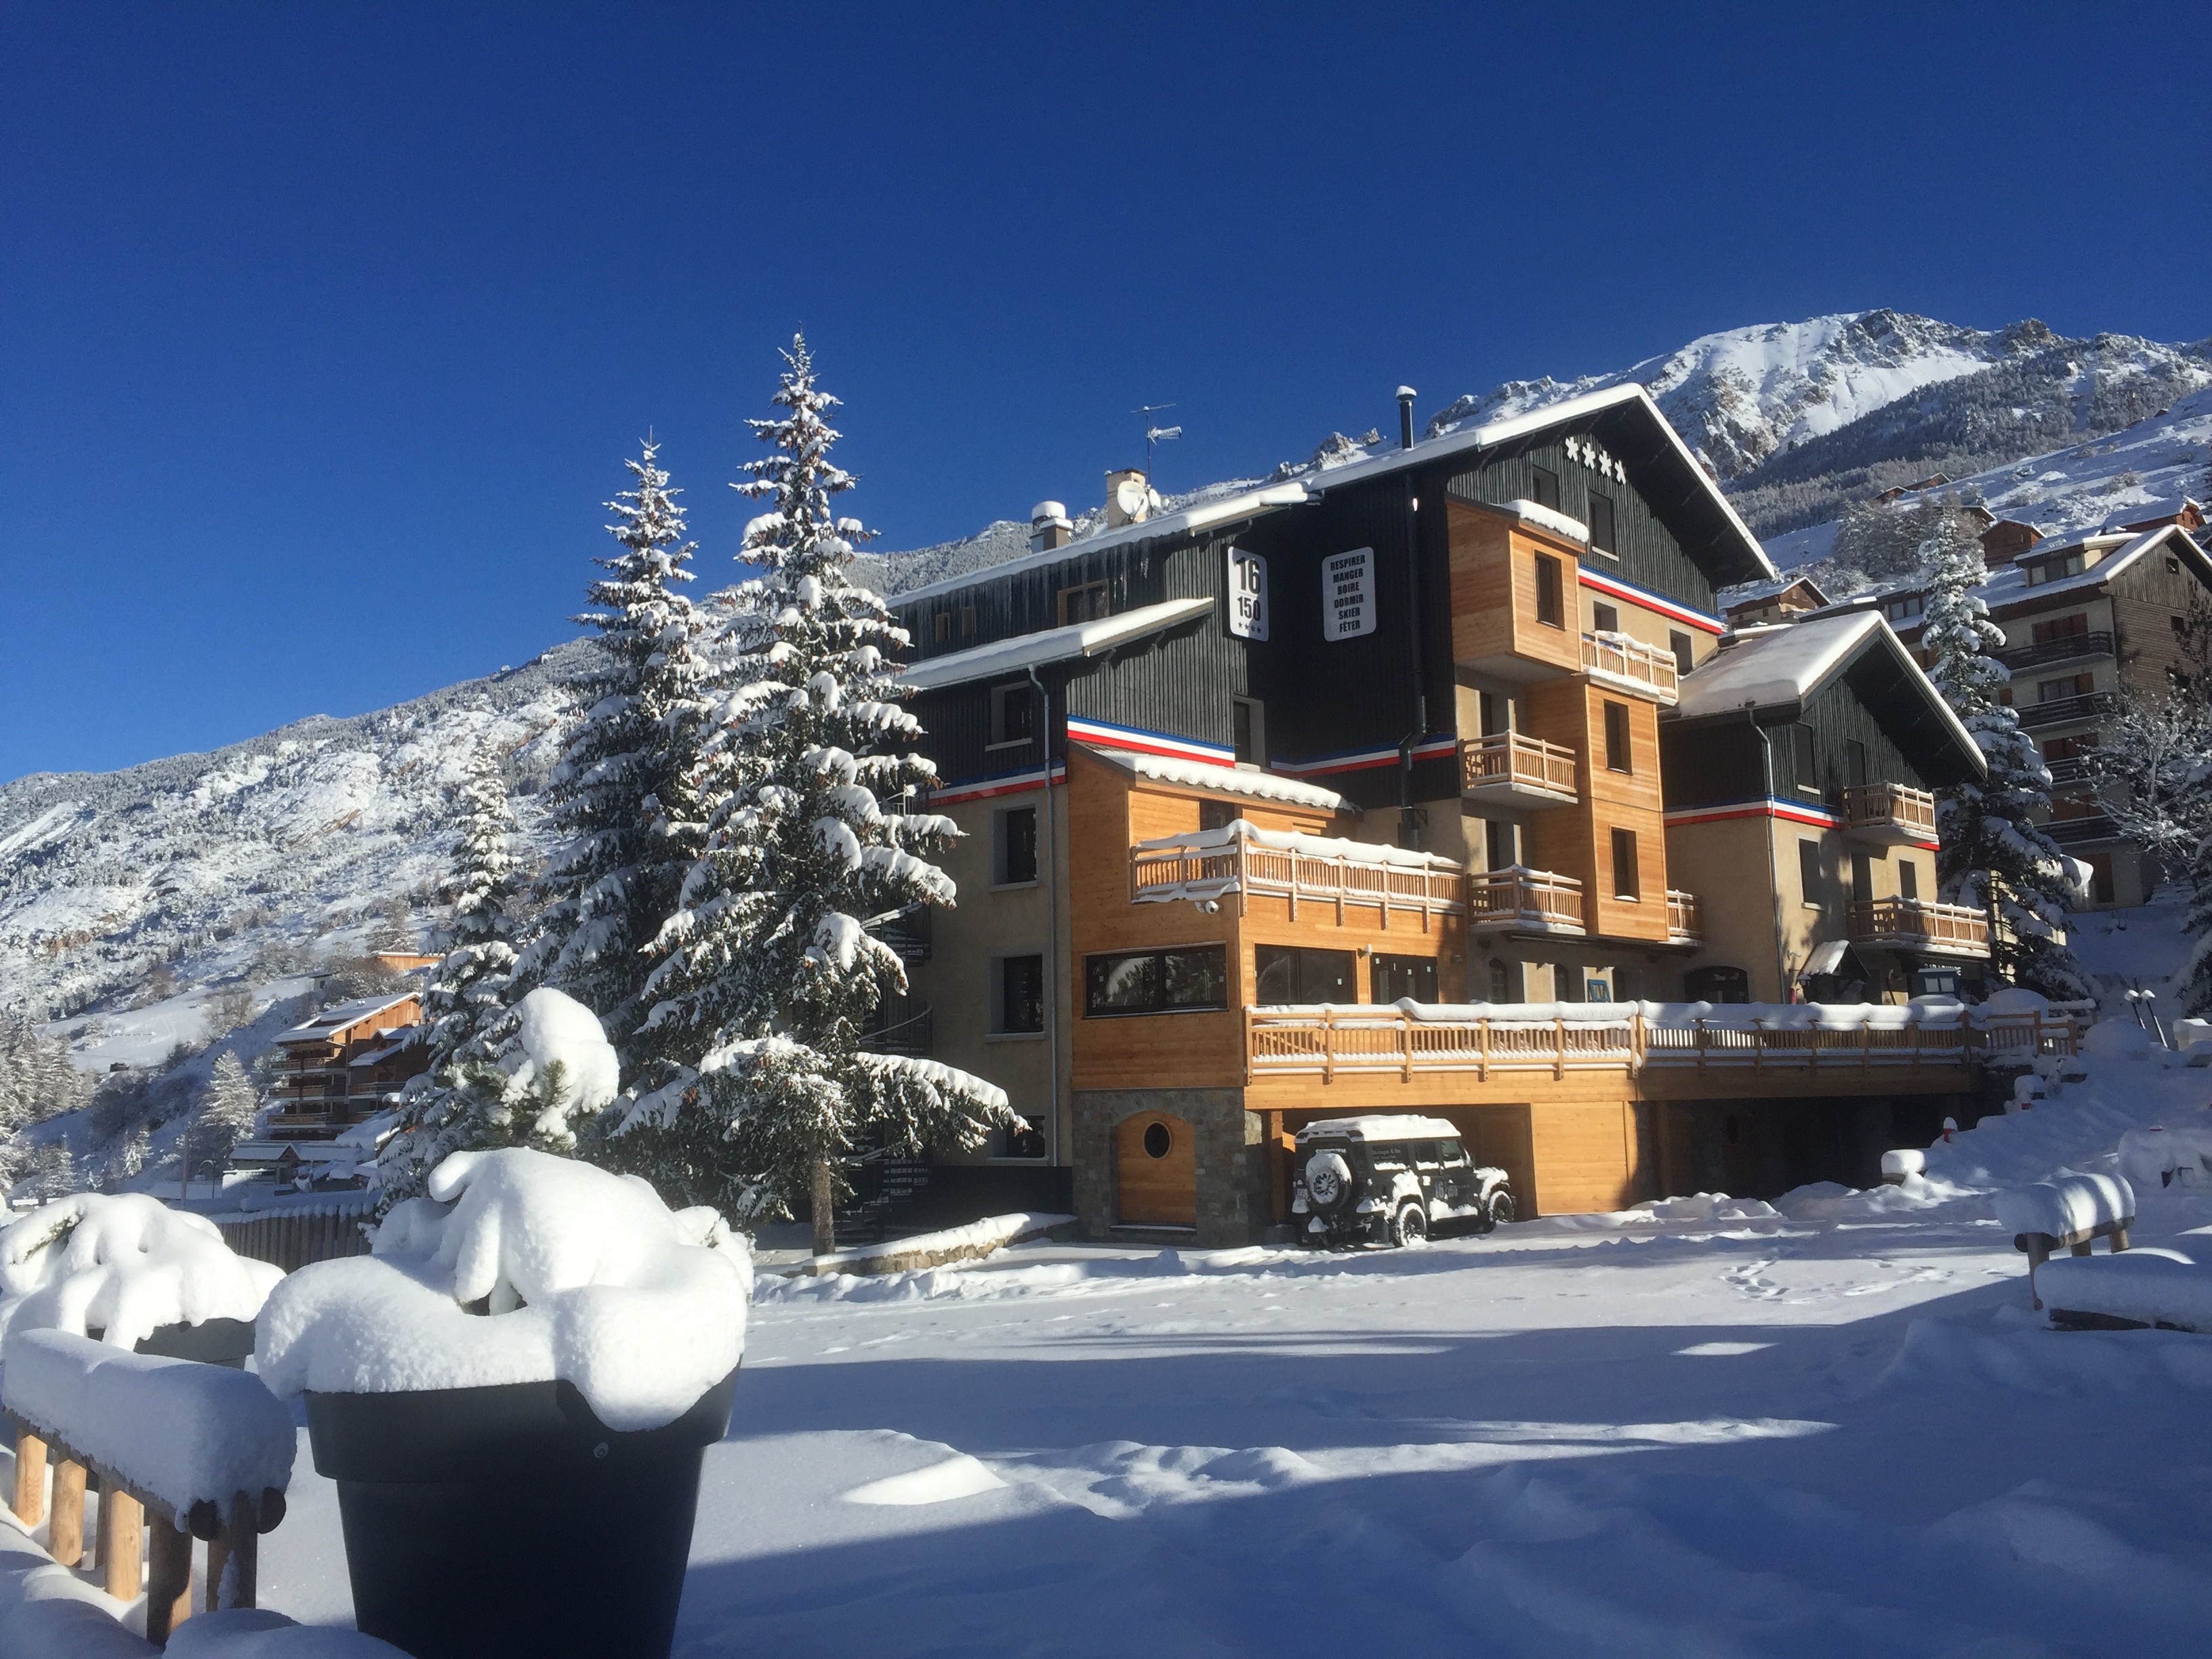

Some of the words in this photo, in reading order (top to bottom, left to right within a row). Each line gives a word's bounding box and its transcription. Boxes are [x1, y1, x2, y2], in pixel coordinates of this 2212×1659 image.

[1330, 554, 1366, 571] RESPIRER
[1236, 557, 1261, 594] 16
[1333, 568, 1364, 583] MANGER
[1337, 581, 1359, 595] BOIRE
[1237, 596, 1261, 621] 150
[1334, 594, 1364, 609] DORMIR
[1338, 607, 1360, 620] SKIER
[1435, 1181, 1444, 1198] 16
